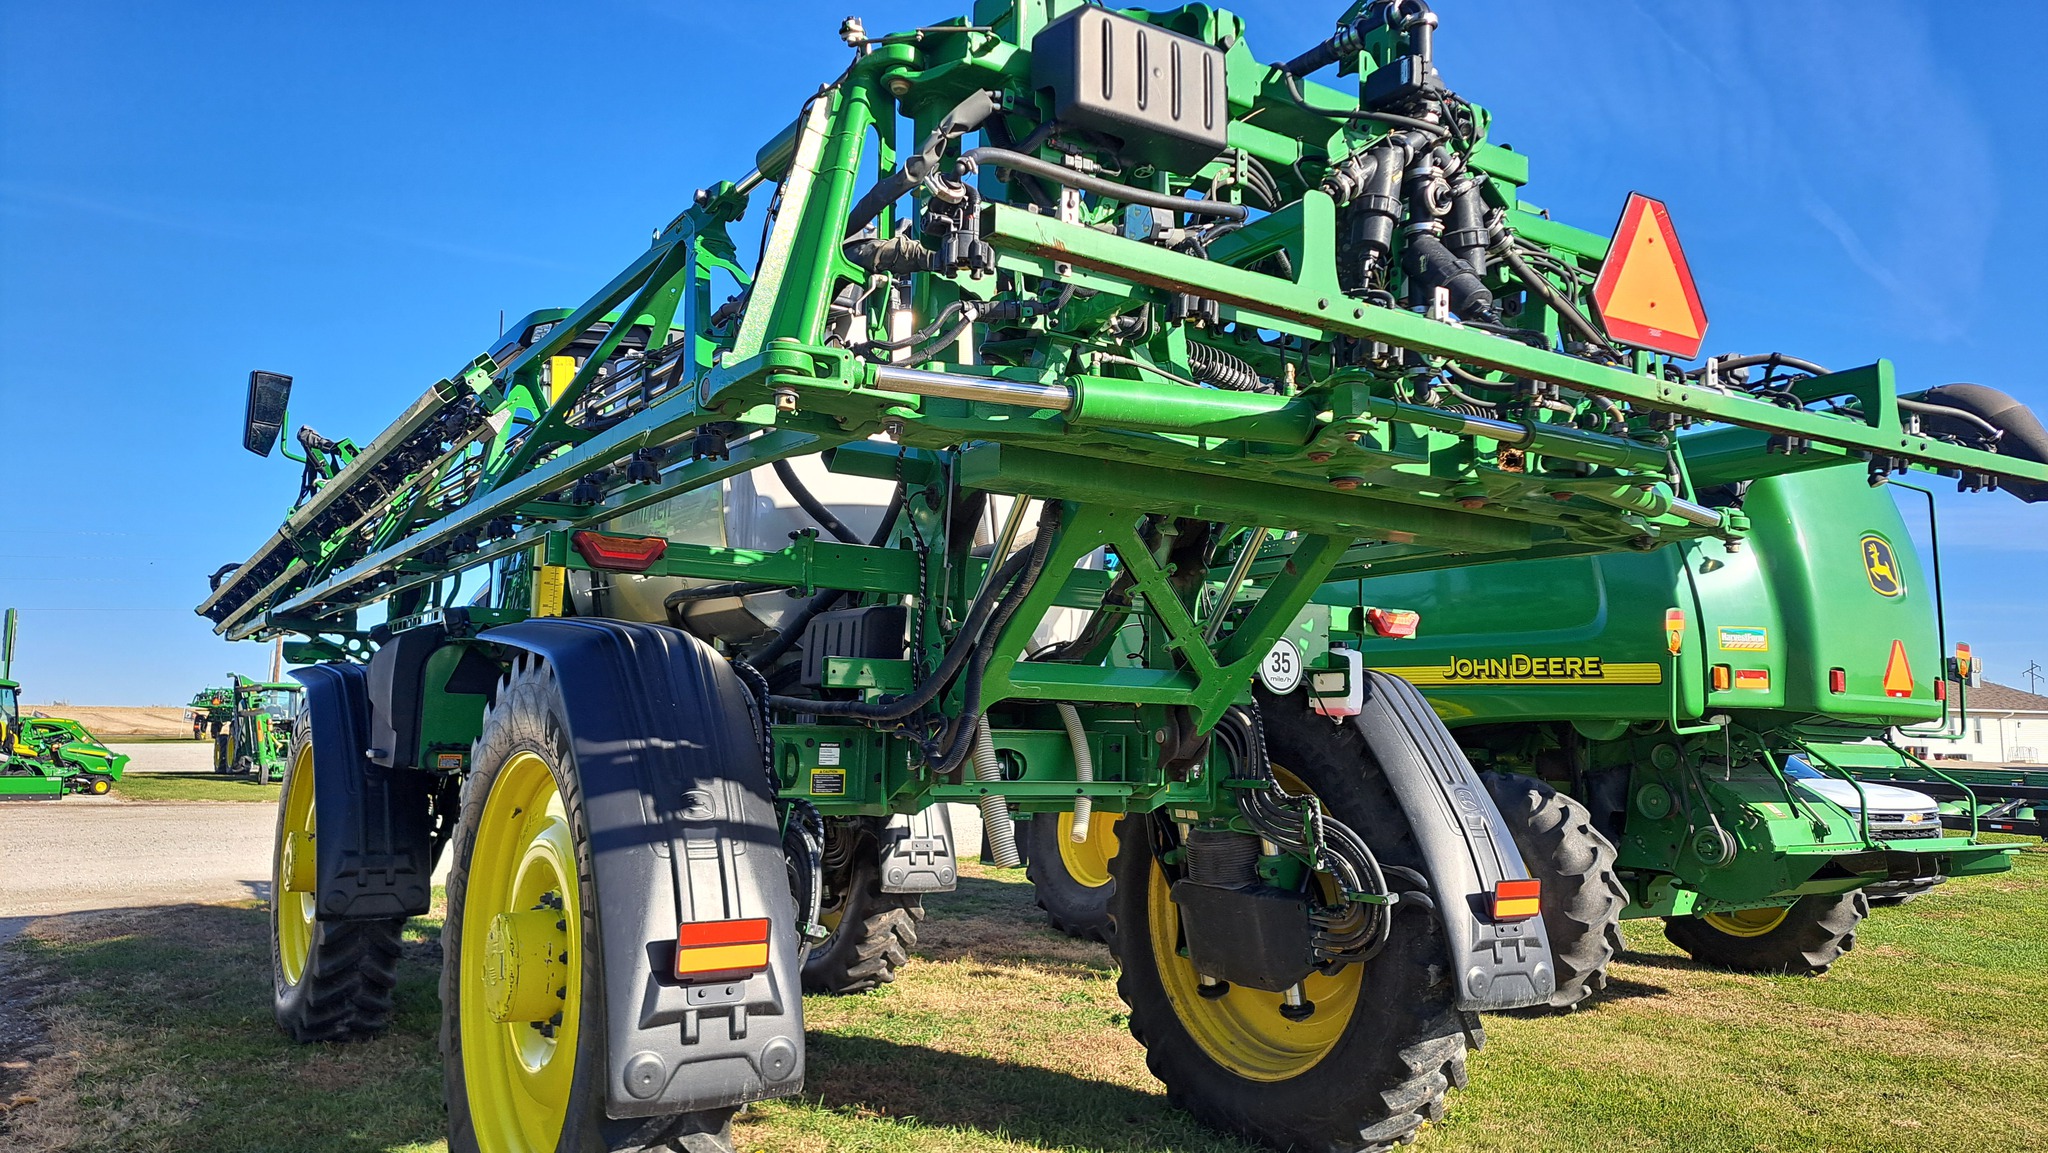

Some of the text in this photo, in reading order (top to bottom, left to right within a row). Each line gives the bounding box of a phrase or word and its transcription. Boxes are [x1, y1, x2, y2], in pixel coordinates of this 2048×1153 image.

[1271, 651, 1291, 674] 35
[1443, 653, 1602, 678] JOHN DEERE
[1270, 675, 1292, 683] mile/h
